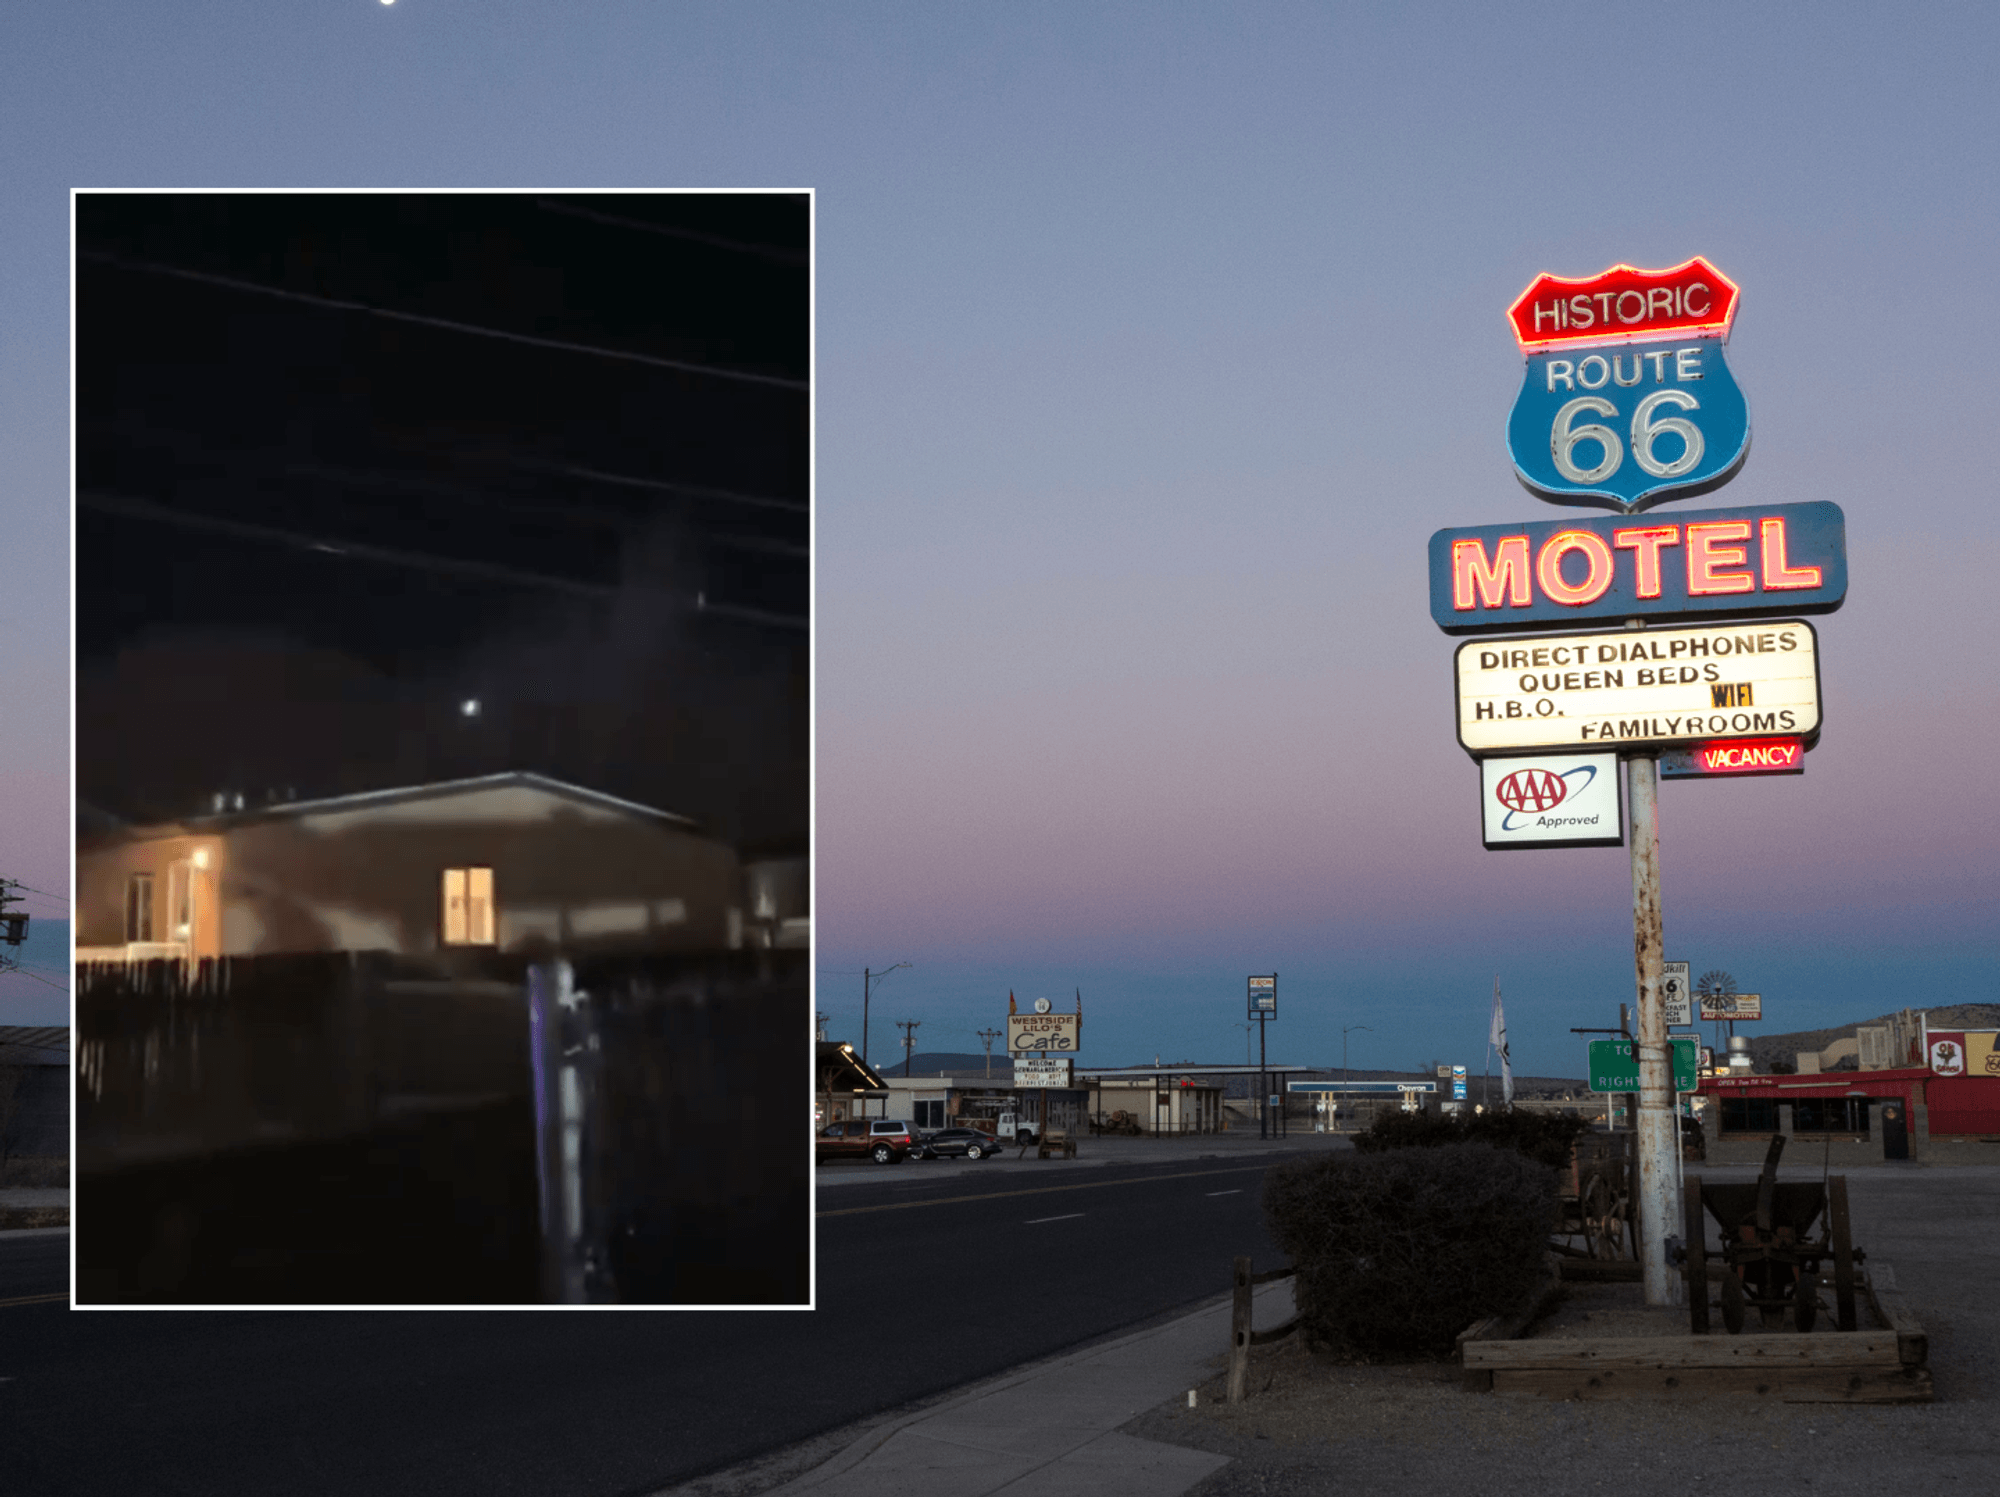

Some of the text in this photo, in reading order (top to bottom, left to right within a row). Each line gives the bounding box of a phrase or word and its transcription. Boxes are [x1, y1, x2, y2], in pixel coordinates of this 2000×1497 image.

[1534, 282, 1711, 333] HISTORIC
[1547, 348, 1704, 392] ROUTE
[1550, 390, 1705, 484] 66
[1452, 516, 1823, 610] MOTEL
[1480, 646, 1589, 670] DIRECT
[1519, 663, 1720, 692] QUEEN BEDS
[1711, 683, 1754, 708] WIFI
[1476, 699, 1565, 720] H.B.O.
[1705, 746, 1796, 769] VACANCY
[1500, 769, 1565, 812] AAA
[1536, 814, 1600, 829] Approved
[1666, 993, 1677, 1001] FE
[1012, 1016, 1073, 1025] WESTSIDE
[1014, 1033, 1071, 1050] Cafe
